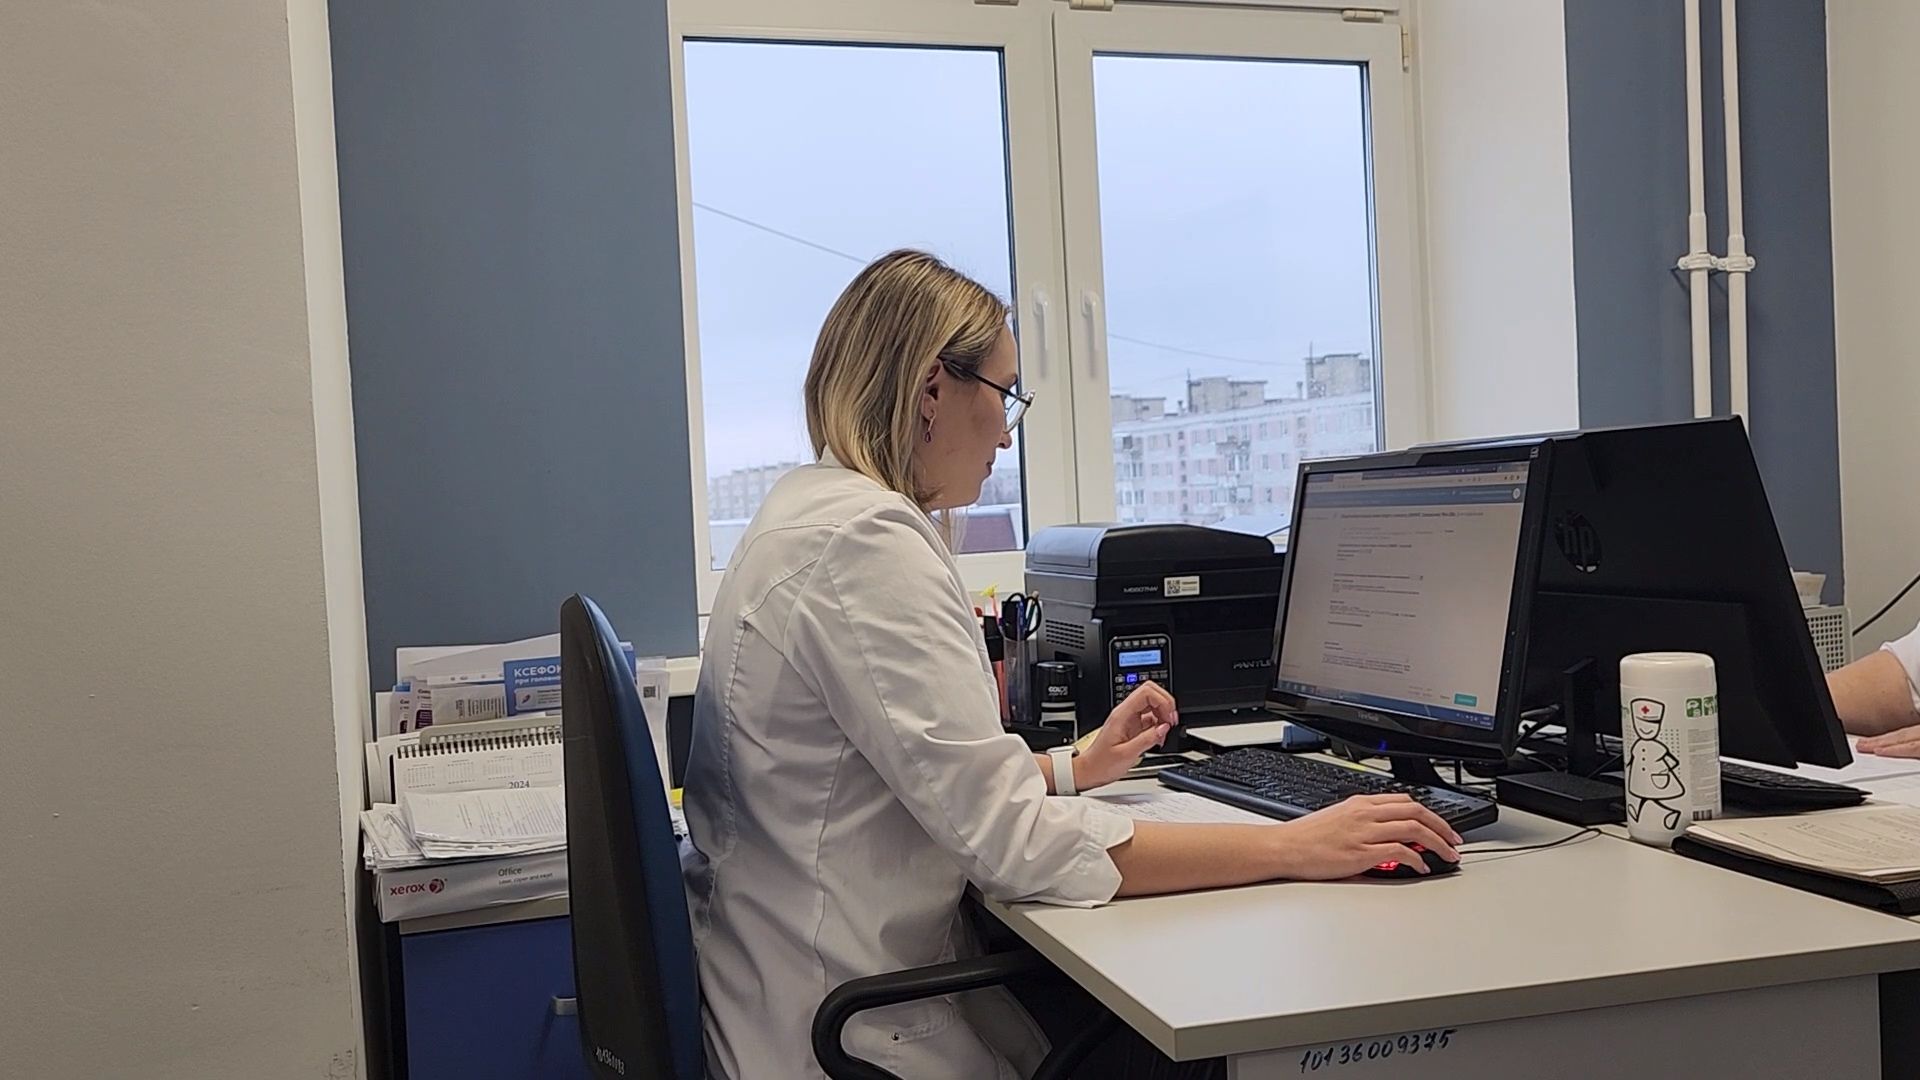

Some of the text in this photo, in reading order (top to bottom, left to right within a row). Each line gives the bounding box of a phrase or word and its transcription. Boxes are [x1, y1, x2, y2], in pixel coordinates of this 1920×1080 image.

[508, 780, 530, 789] 2024
[498, 867, 523, 877] Office
[390, 883, 426, 896] xerox
